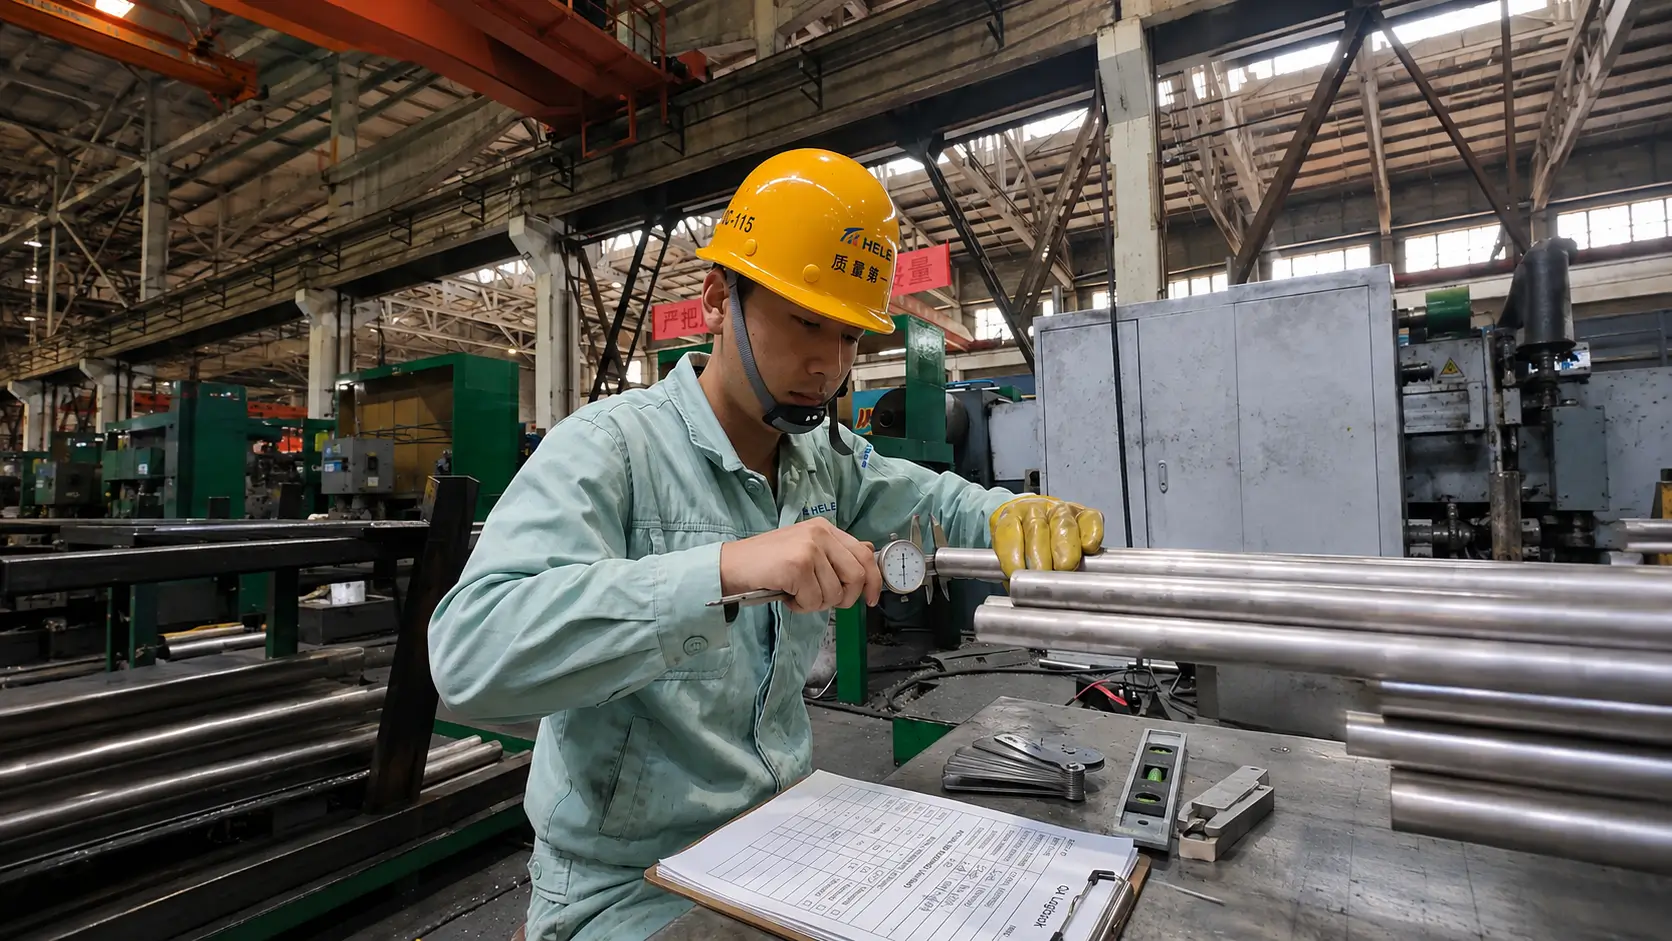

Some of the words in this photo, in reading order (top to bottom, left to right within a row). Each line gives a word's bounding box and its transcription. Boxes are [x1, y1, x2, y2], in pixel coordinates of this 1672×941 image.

[862, 237, 892, 262] HELE
[831, 253, 888, 284] 质量第一
[662, 307, 705, 333] 严把
[811, 501, 837, 515] HELE
